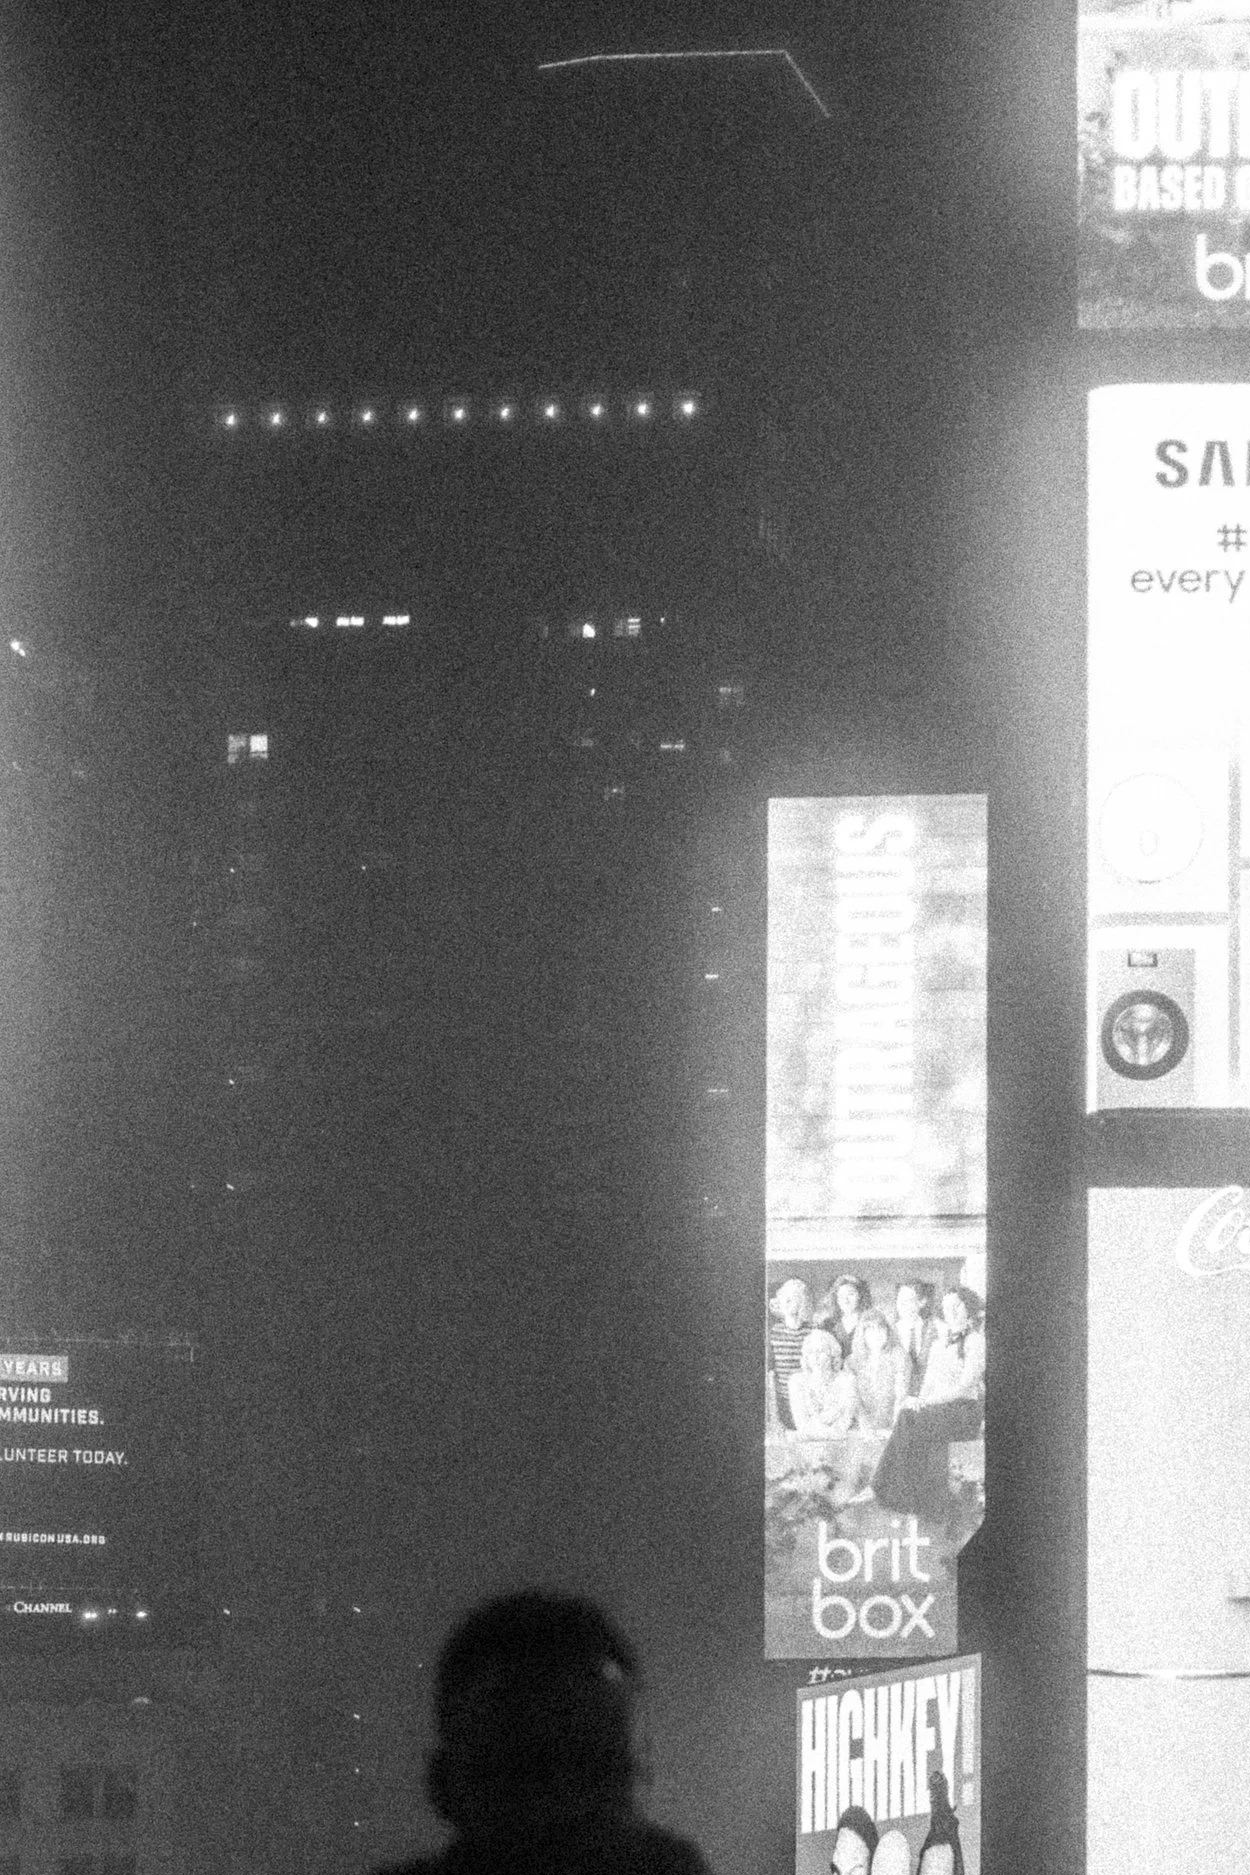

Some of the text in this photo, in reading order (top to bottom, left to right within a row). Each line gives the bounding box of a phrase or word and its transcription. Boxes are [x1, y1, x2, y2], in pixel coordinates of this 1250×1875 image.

[1112, 165, 1227, 211] BASED
[1130, 568, 1246, 604] every
[4, 1359, 62, 1377] YEARS
[0, 1447, 129, 1466] UNTEER TODAY.
[818, 1519, 931, 1582] brit
[811, 1577, 936, 1640] box
